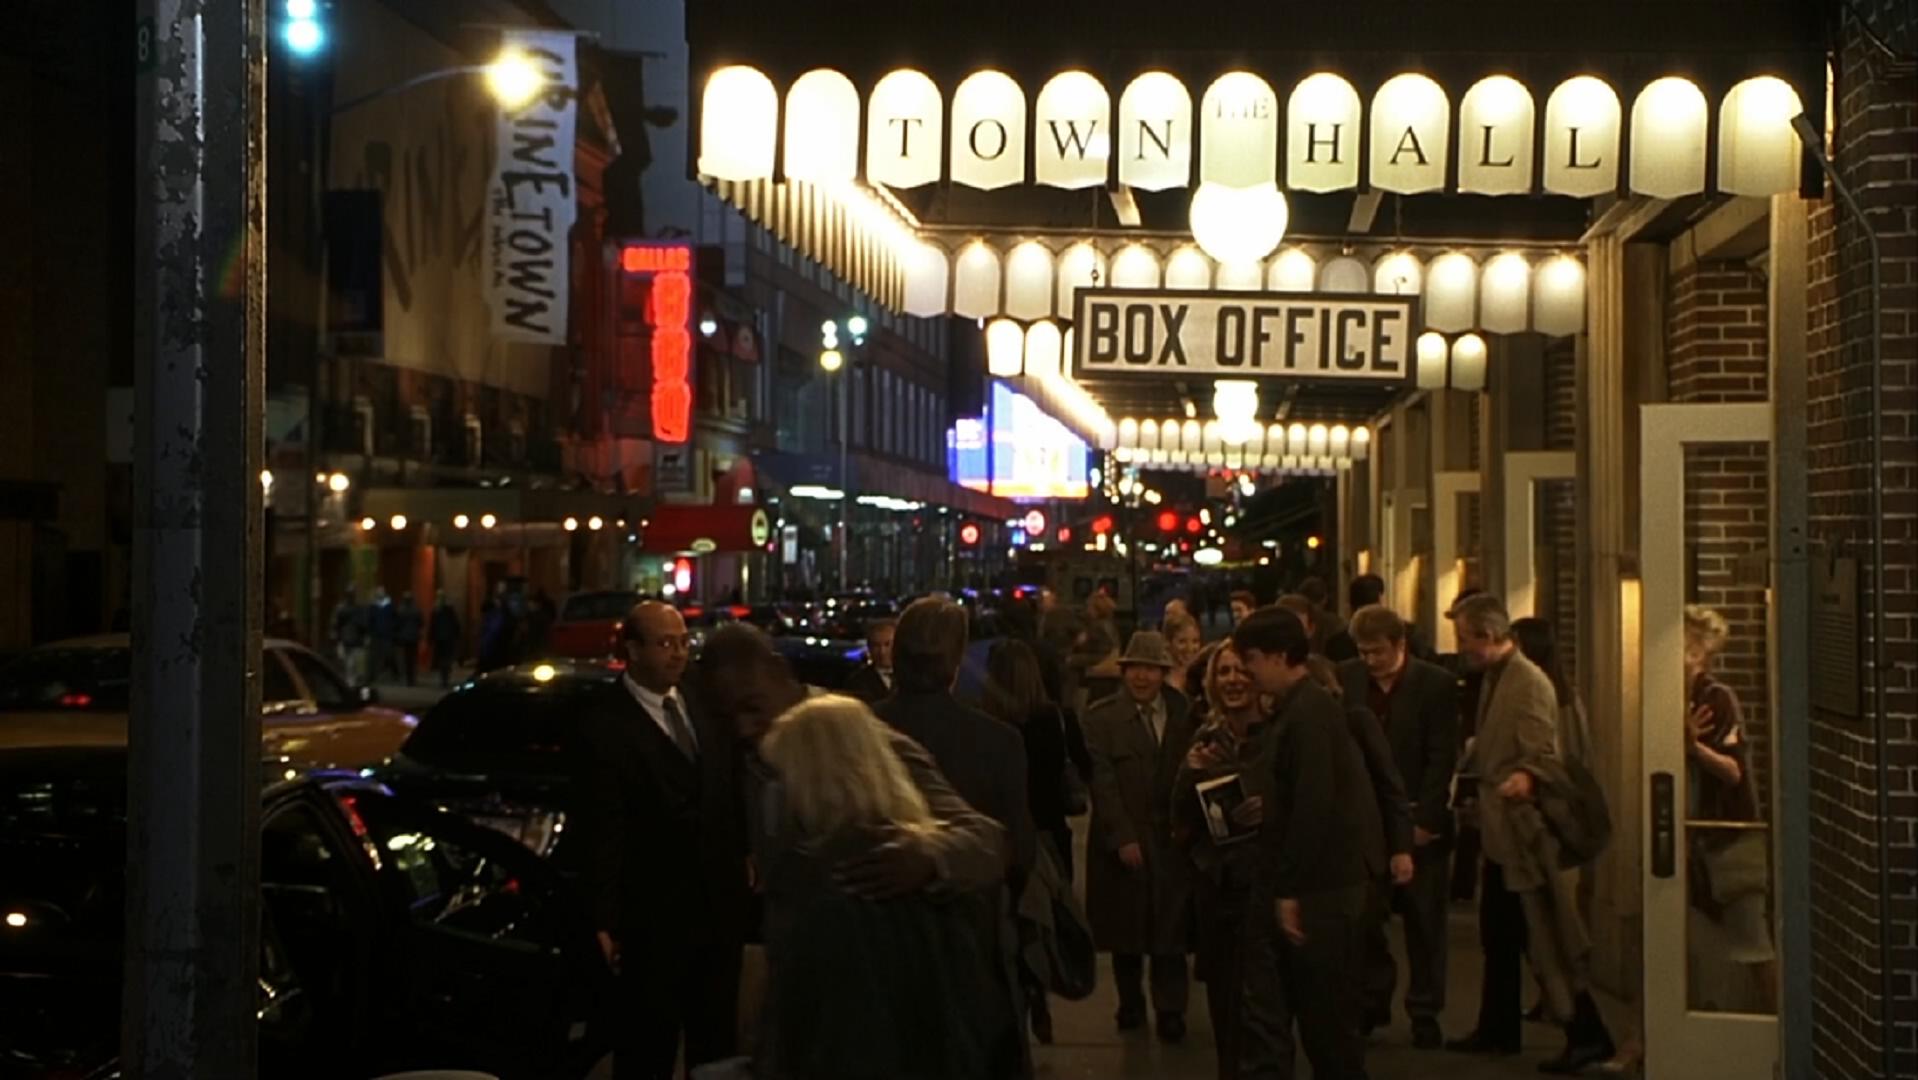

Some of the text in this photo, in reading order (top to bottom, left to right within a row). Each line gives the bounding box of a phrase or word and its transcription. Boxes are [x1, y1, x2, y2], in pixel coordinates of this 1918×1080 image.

[889, 118, 1602, 169] TOWN HALL
[1089, 303, 1401, 372] BOX OFFICE
